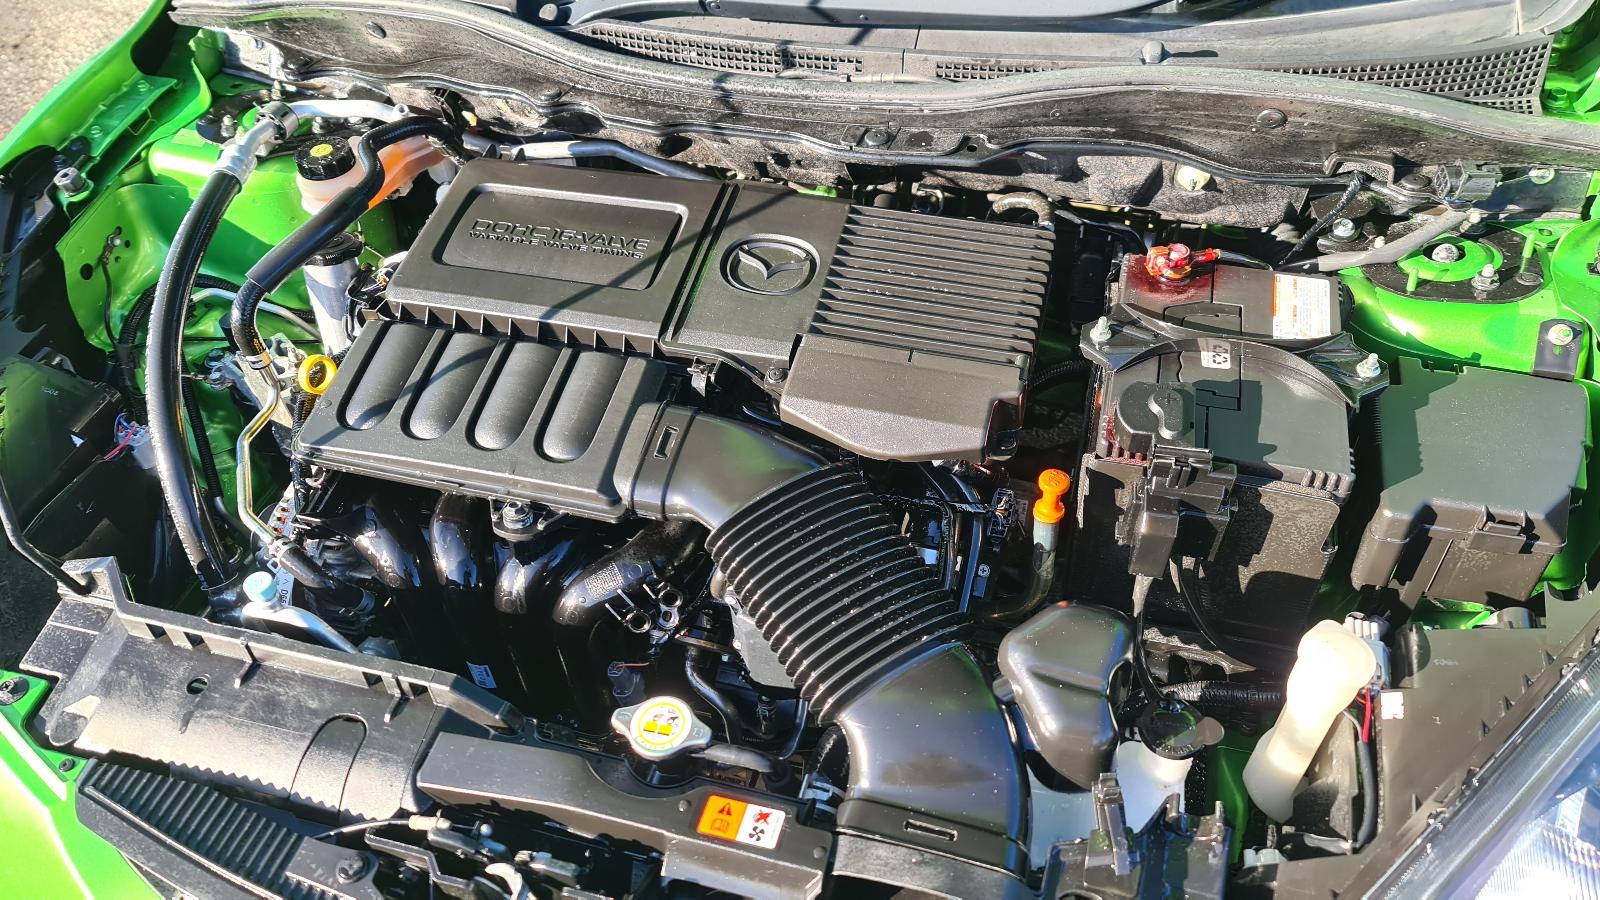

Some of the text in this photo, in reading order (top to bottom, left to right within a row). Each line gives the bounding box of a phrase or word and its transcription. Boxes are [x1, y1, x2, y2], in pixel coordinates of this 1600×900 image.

[469, 230, 644, 259] VARIABLE VALVE TIMING
[471, 218, 650, 251] DOHC 16-VALVE
